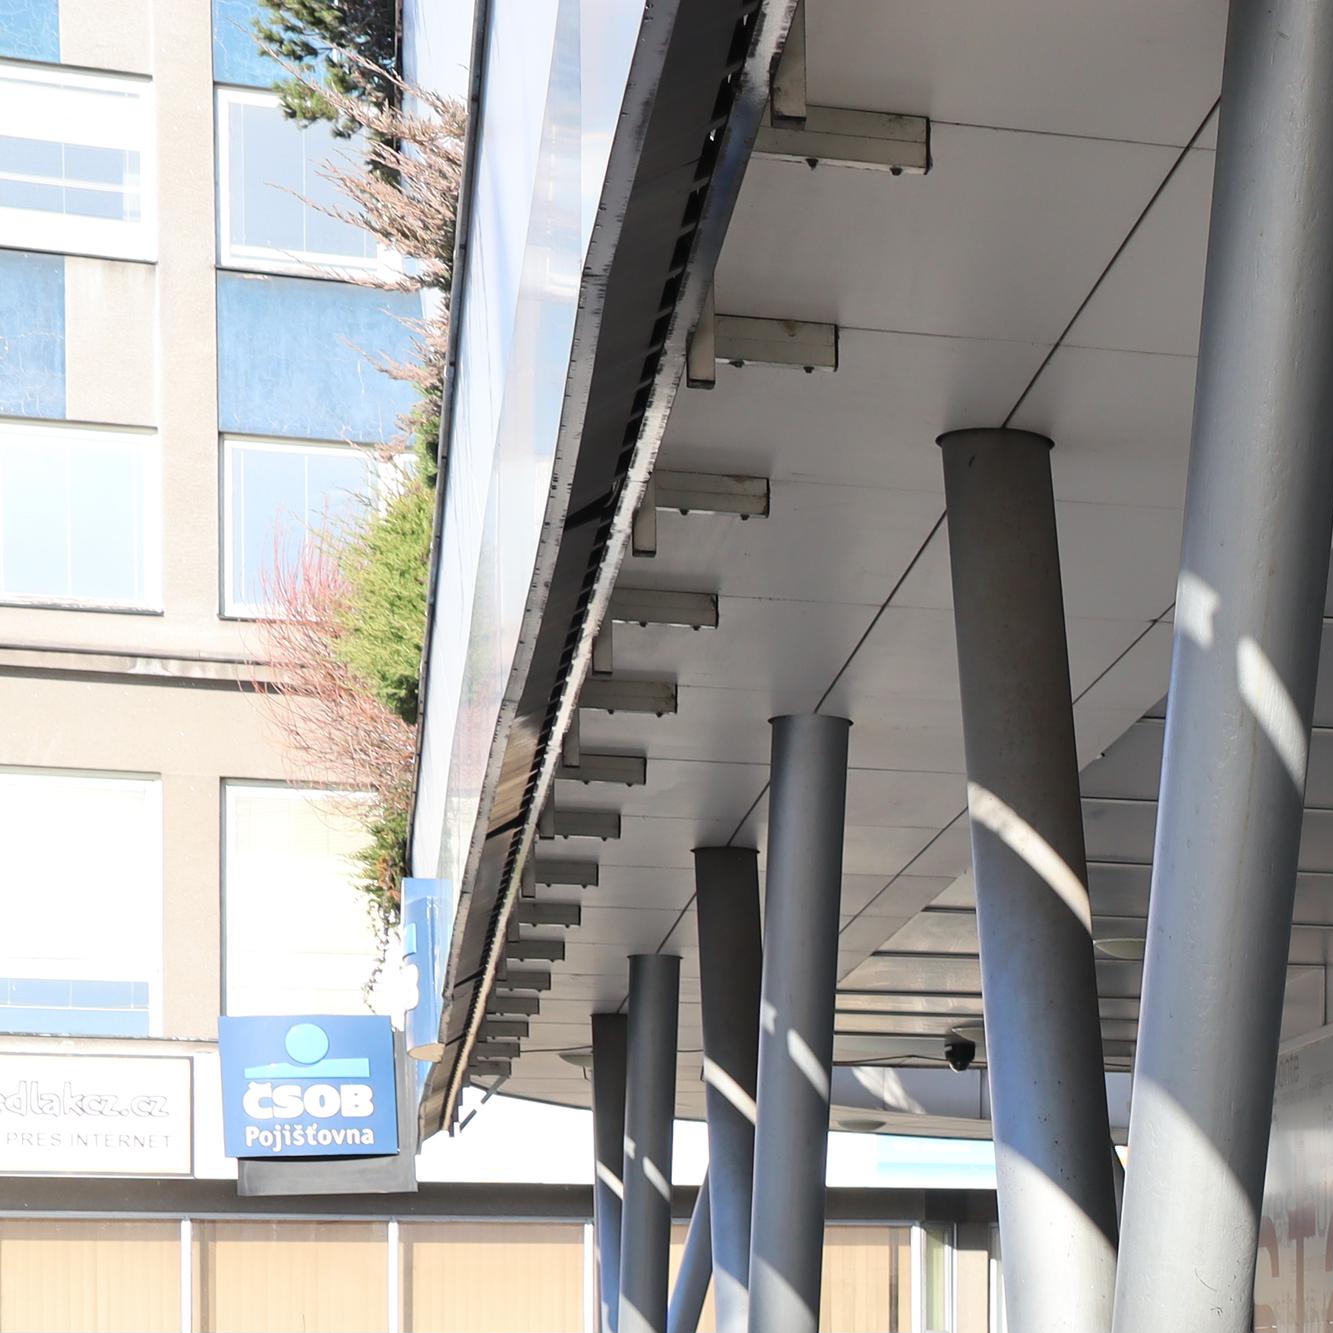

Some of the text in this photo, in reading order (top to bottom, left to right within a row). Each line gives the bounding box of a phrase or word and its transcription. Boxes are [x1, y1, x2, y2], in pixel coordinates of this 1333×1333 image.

[242, 1082, 375, 1120] ČSOB
[68, 1133, 172, 1149] INTERNET
[245, 1124, 375, 1152] Pojišťovna
